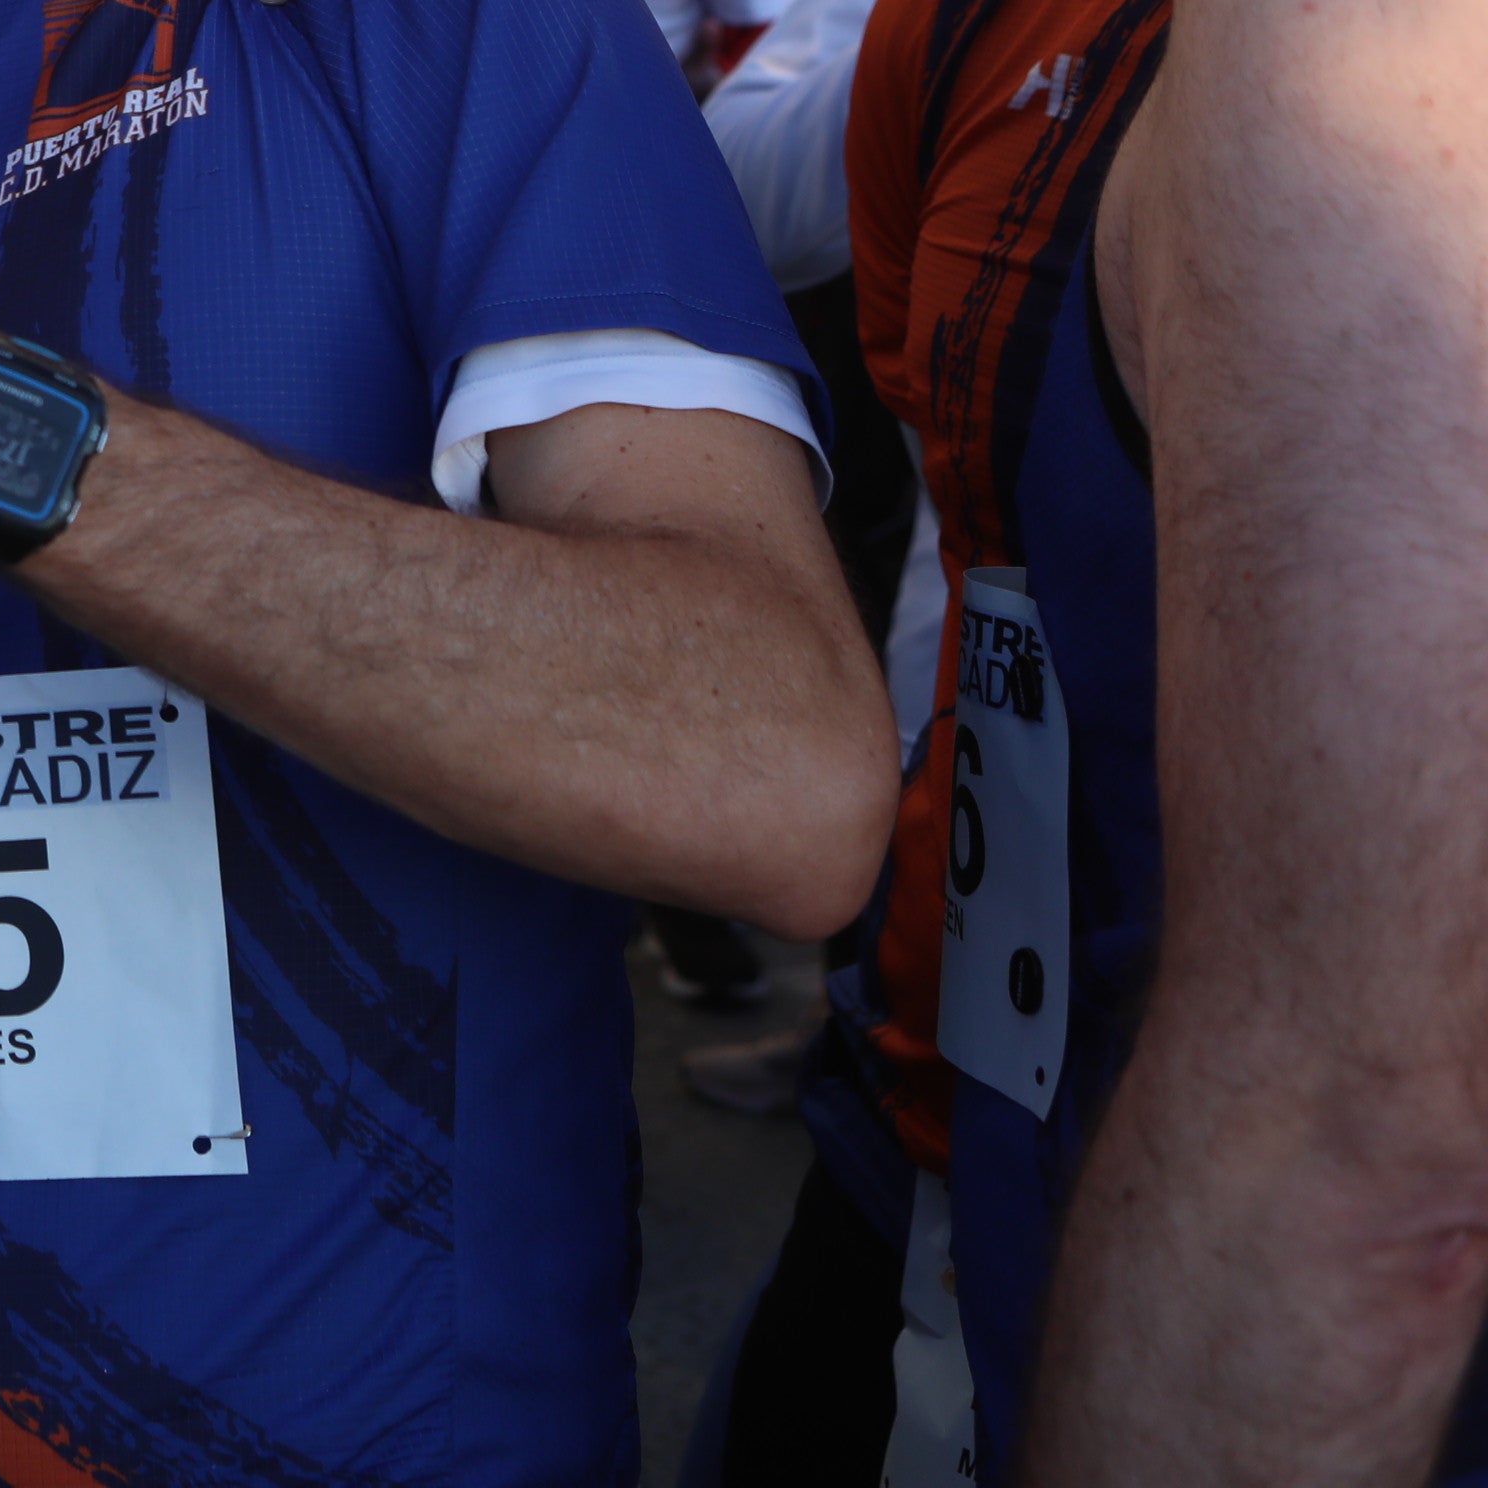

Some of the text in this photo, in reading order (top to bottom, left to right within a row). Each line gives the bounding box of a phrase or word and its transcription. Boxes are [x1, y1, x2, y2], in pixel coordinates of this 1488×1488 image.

[5, 67, 205, 176] PUERTO REAL
[57, 89, 208, 180] MARATON
